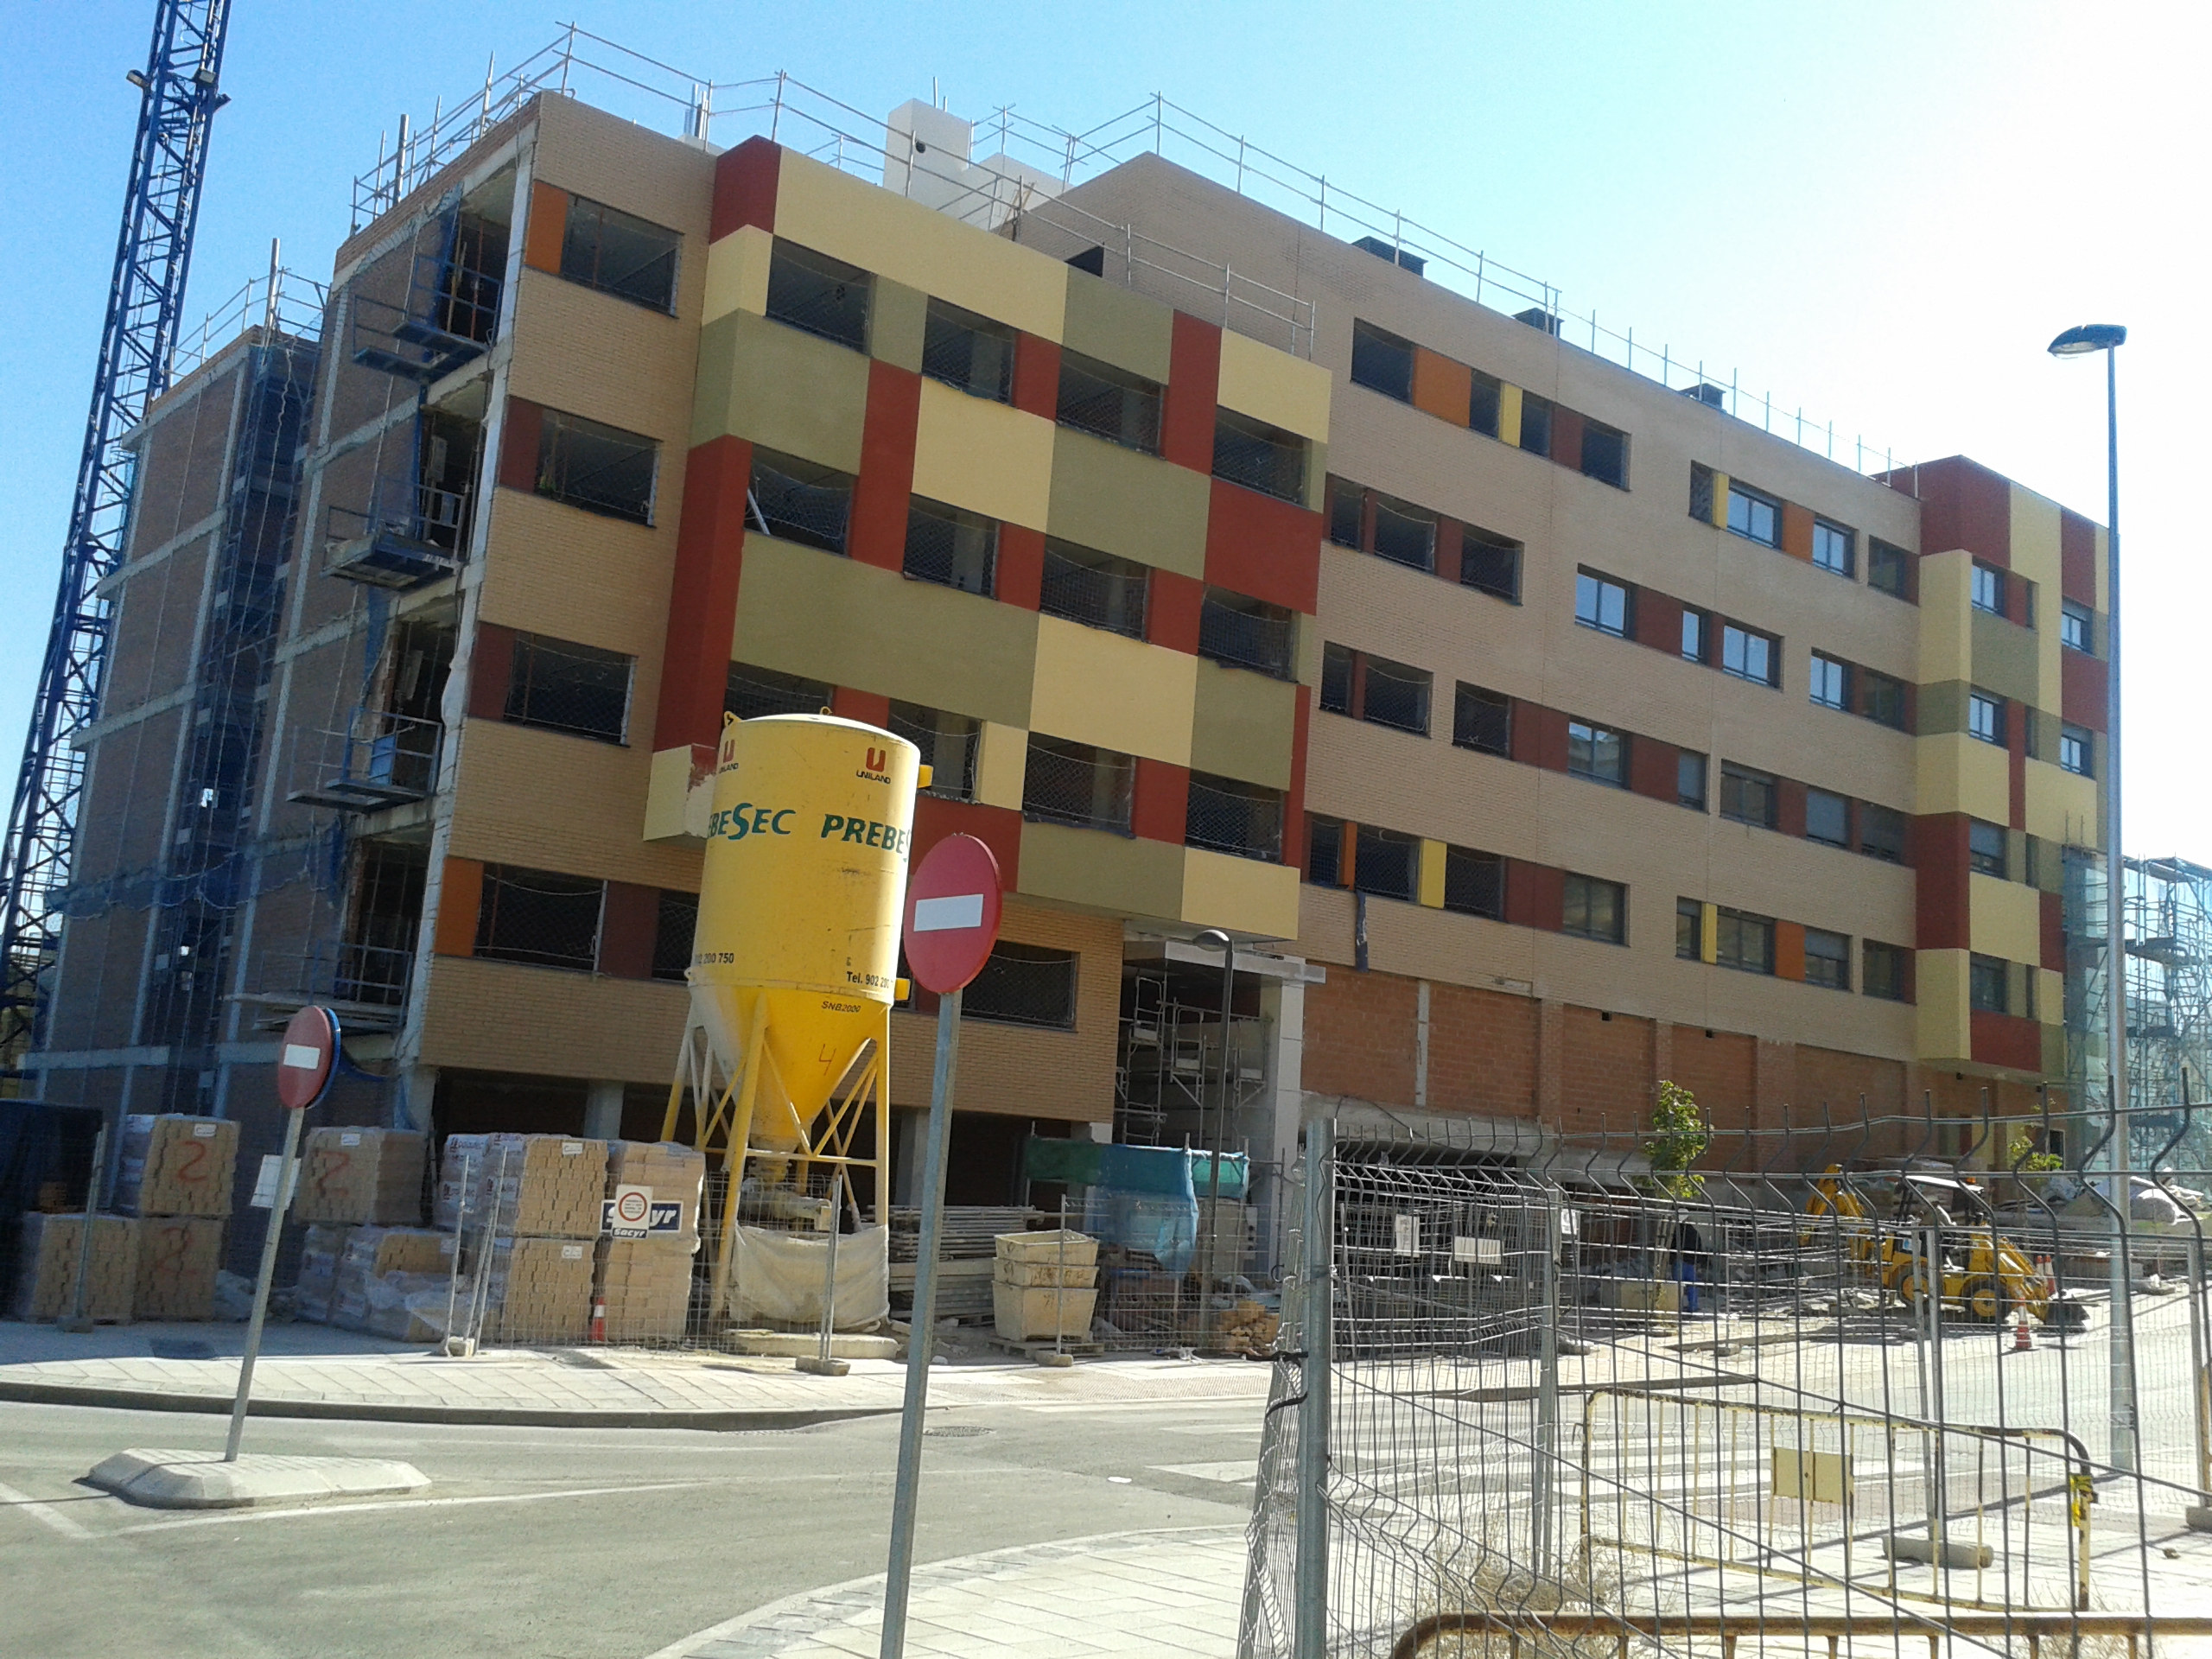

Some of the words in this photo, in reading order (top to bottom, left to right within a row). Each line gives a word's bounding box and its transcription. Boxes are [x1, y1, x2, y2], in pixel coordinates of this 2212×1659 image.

[856, 770, 891, 785] UNILAND
[718, 952, 734, 964] 750
[847, 971, 863, 983] Tel.
[865, 974, 879, 987] 902
